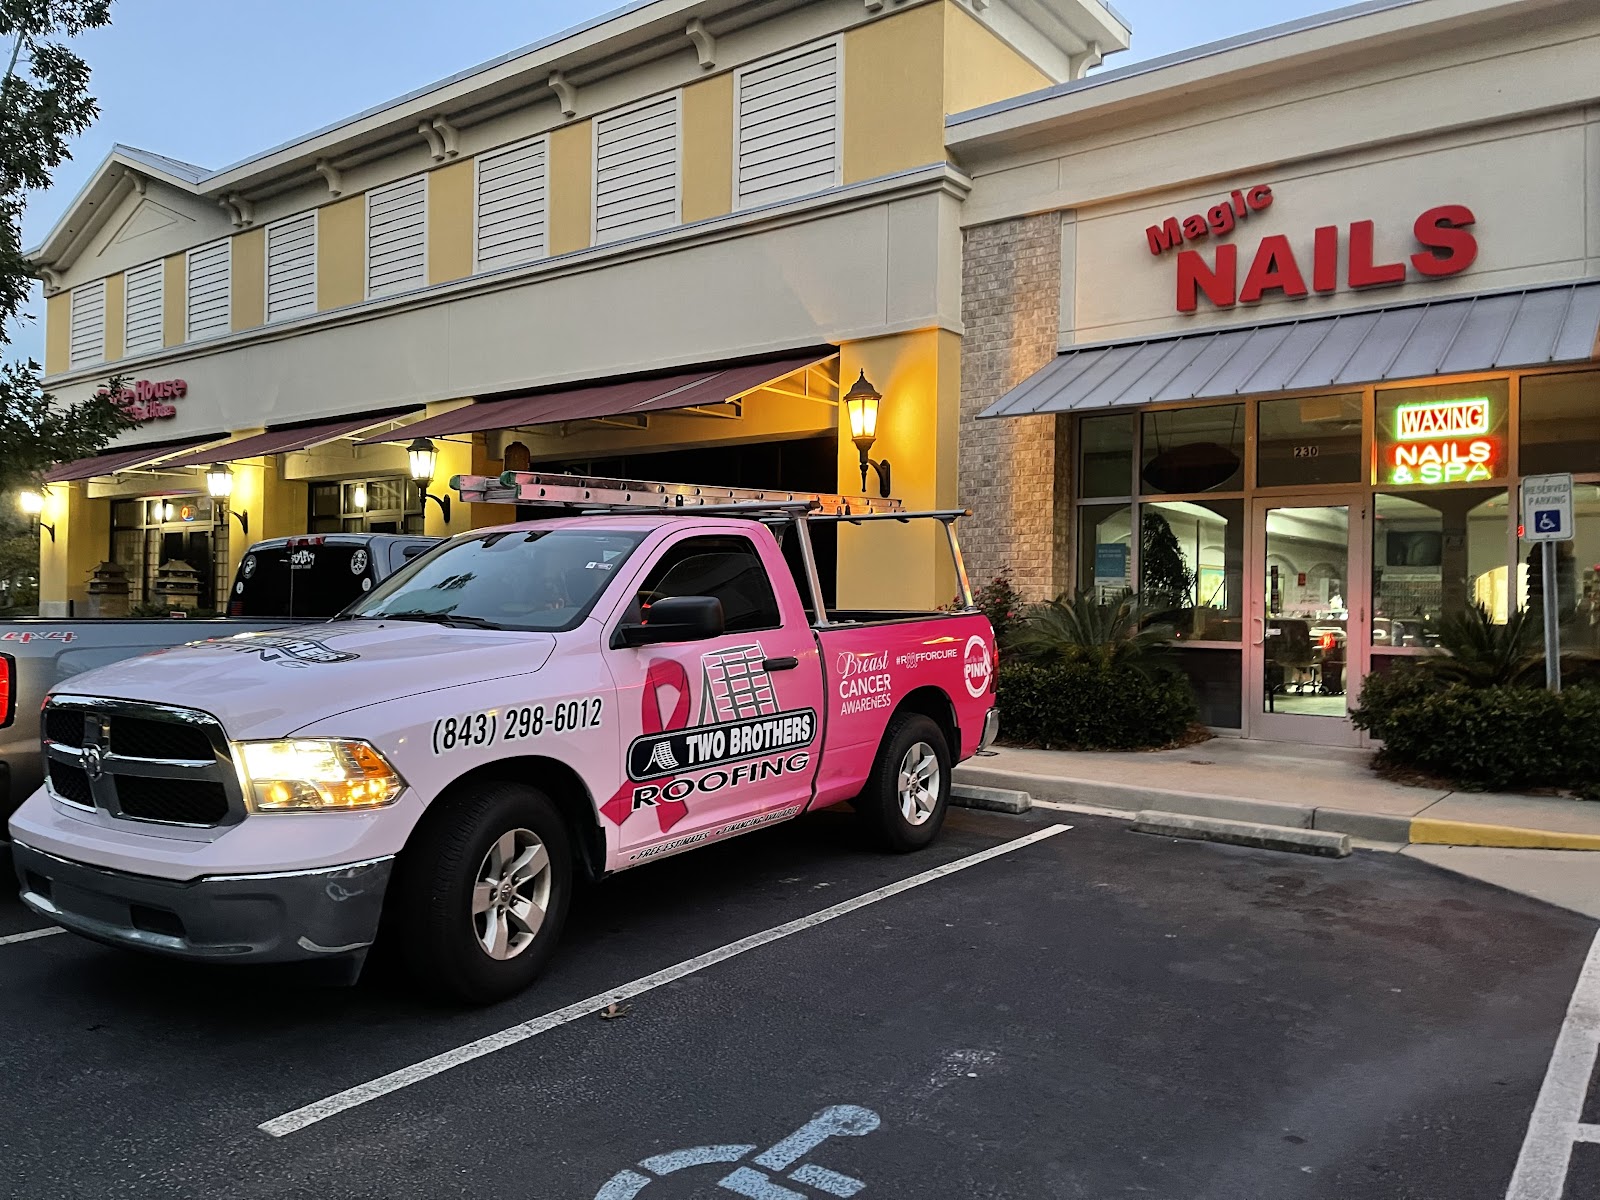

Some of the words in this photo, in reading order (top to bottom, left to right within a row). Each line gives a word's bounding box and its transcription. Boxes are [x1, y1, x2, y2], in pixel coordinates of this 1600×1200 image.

[1146, 184, 1273, 256] Magic
[1176, 204, 1478, 312] NAILS
[136, 379, 187, 401] House
[1402, 405, 1483, 433] WAXING
[1295, 446, 1318, 458] 230
[1395, 441, 1491, 466] NAILS
[1393, 464, 1413, 484] &
[1420, 461, 1492, 484] SPA
[1525, 484, 1570, 495] RESERVED
[1528, 495, 1566, 505] PARKING
[837, 650, 889, 679] Breast
[965, 661, 987, 679] PINK
[839, 673, 891, 699] CANCER
[840, 692, 891, 716] AWARENESS
[432, 713, 497, 755] (843)
[503, 698, 602, 740] 298-6012
[686, 730, 726, 763] TWO
[730, 714, 811, 756] BROTHERS
[632, 752, 810, 812] ROOFING
[637, 845, 662, 860] FREE
[662, 831, 710, 851] ESTIMATES
